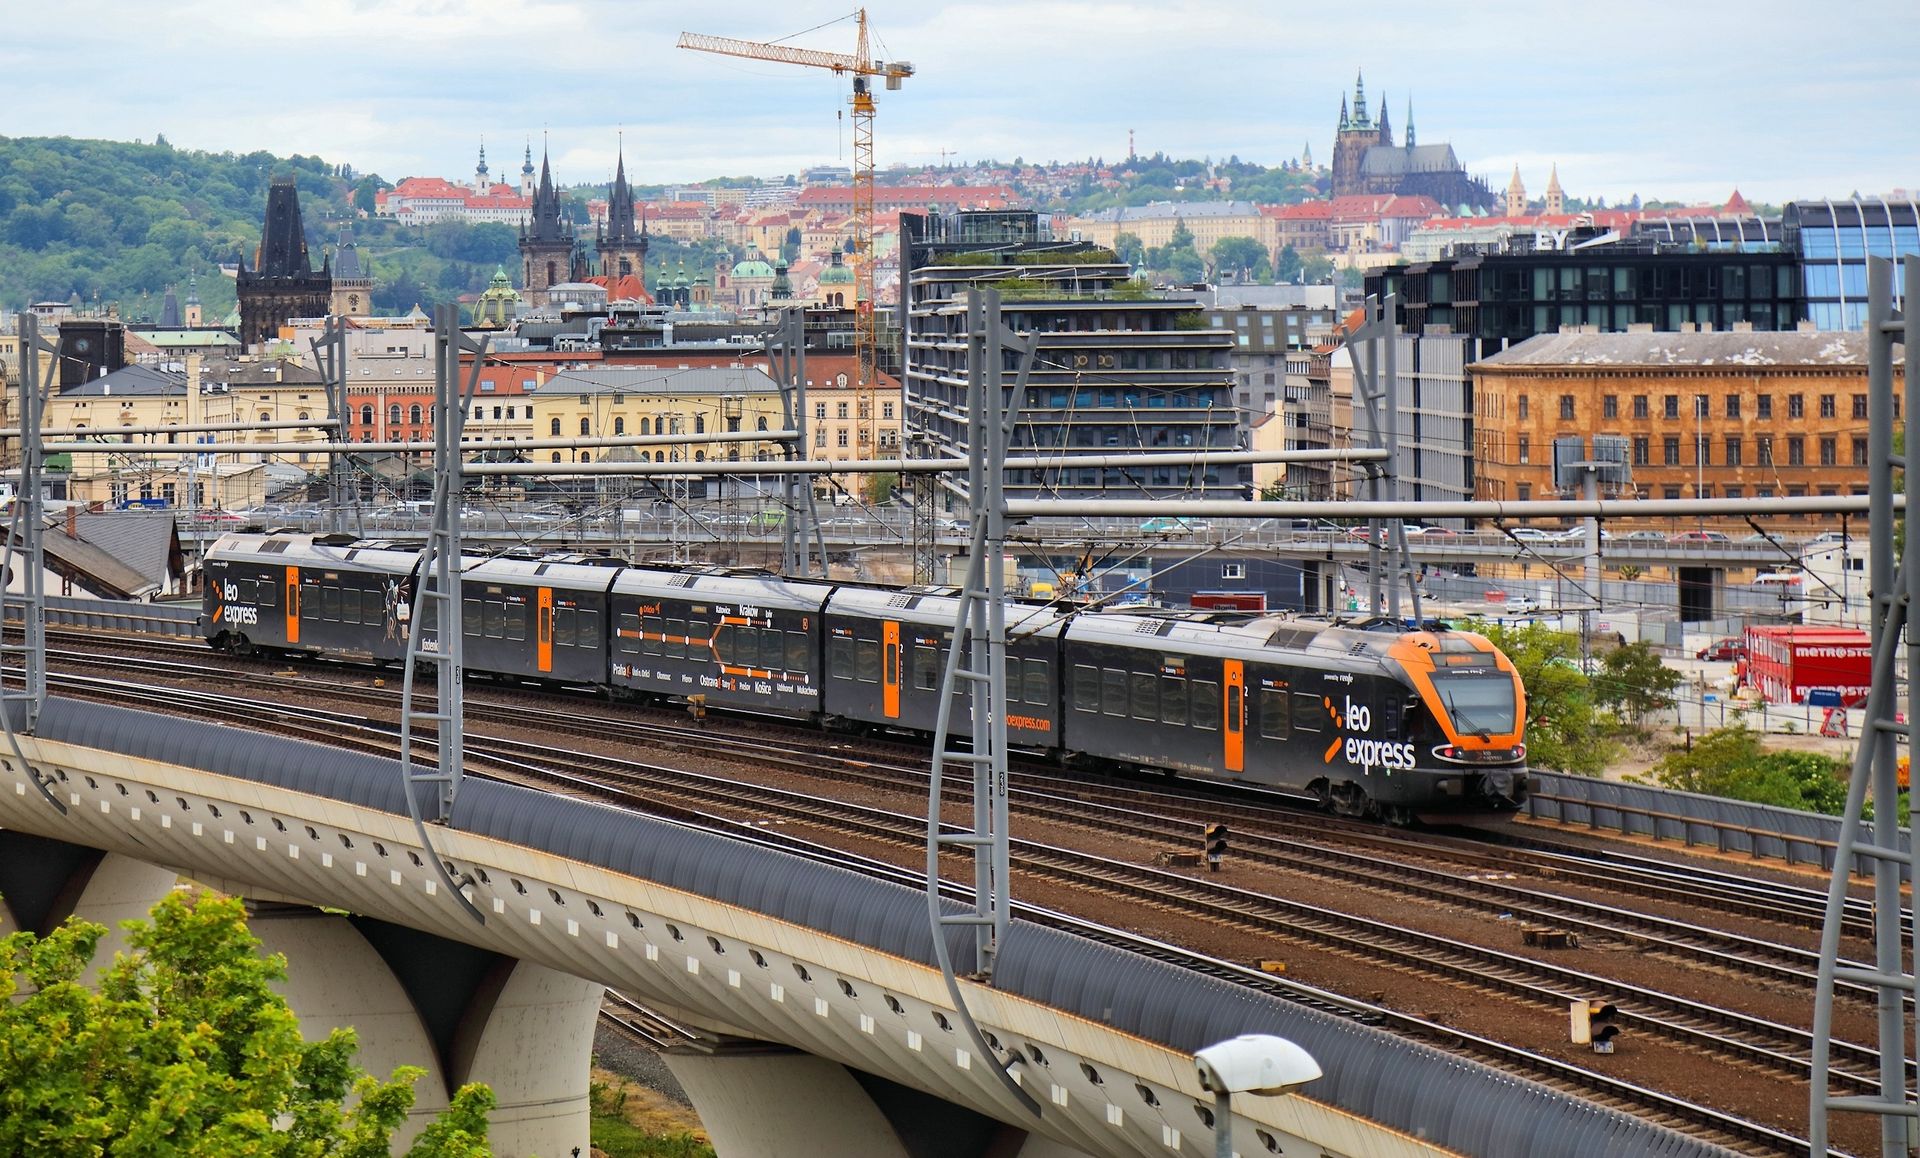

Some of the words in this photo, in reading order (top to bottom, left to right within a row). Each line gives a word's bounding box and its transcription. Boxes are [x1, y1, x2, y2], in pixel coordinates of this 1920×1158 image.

[1536, 230, 1568, 250] EY
[224, 578, 238, 601] leo
[224, 605, 257, 629] express
[739, 604, 759, 618] Kraków
[612, 663, 627, 676] Praha
[700, 674, 718, 689] Ostrava
[754, 681, 772, 695] Košice
[1244, 686, 1249, 697] 2
[1345, 695, 1371, 732] leo
[1345, 738, 1417, 775] express
